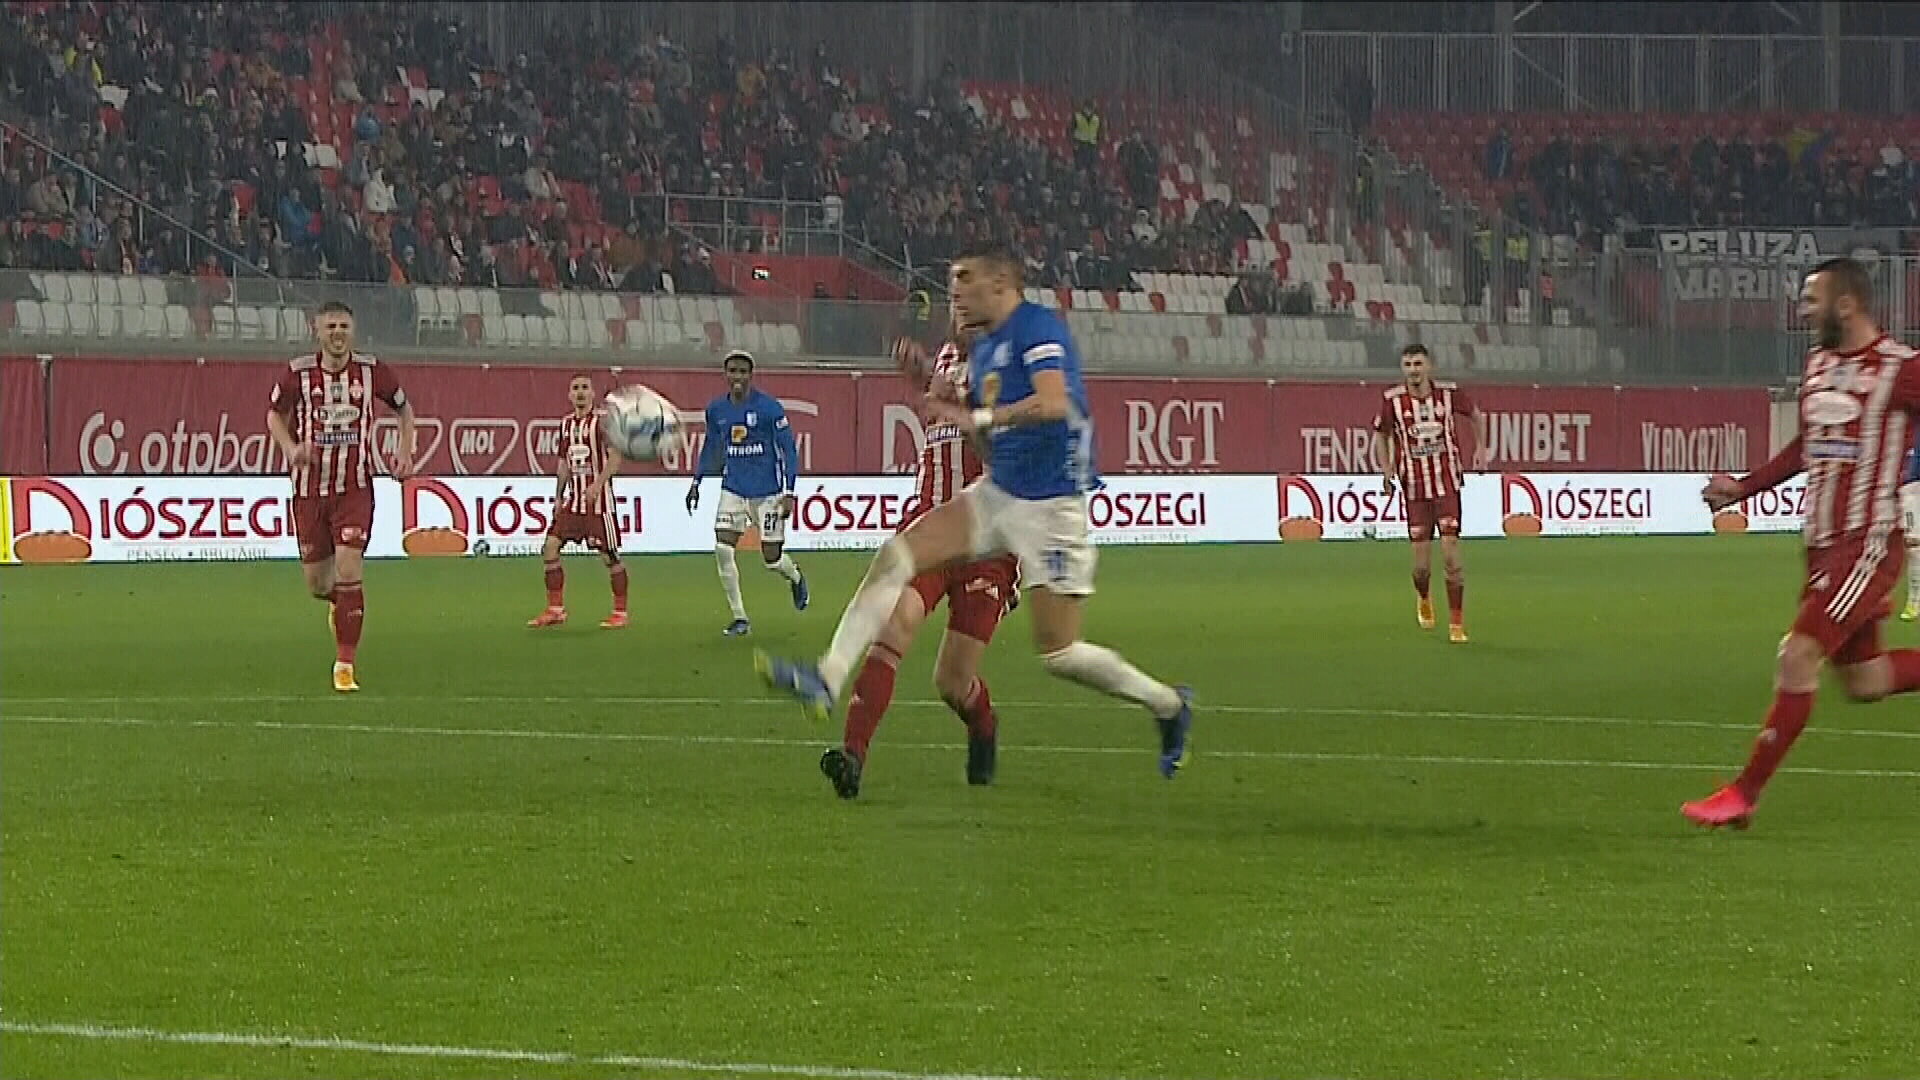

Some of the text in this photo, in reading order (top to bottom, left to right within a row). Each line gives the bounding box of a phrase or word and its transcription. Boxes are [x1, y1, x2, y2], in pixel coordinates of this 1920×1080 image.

[1659, 231, 1819, 264] PELUZA
[460, 429, 496, 454] MOL
[1125, 399, 1225, 466] RGT
[763, 511, 779, 531] 27
